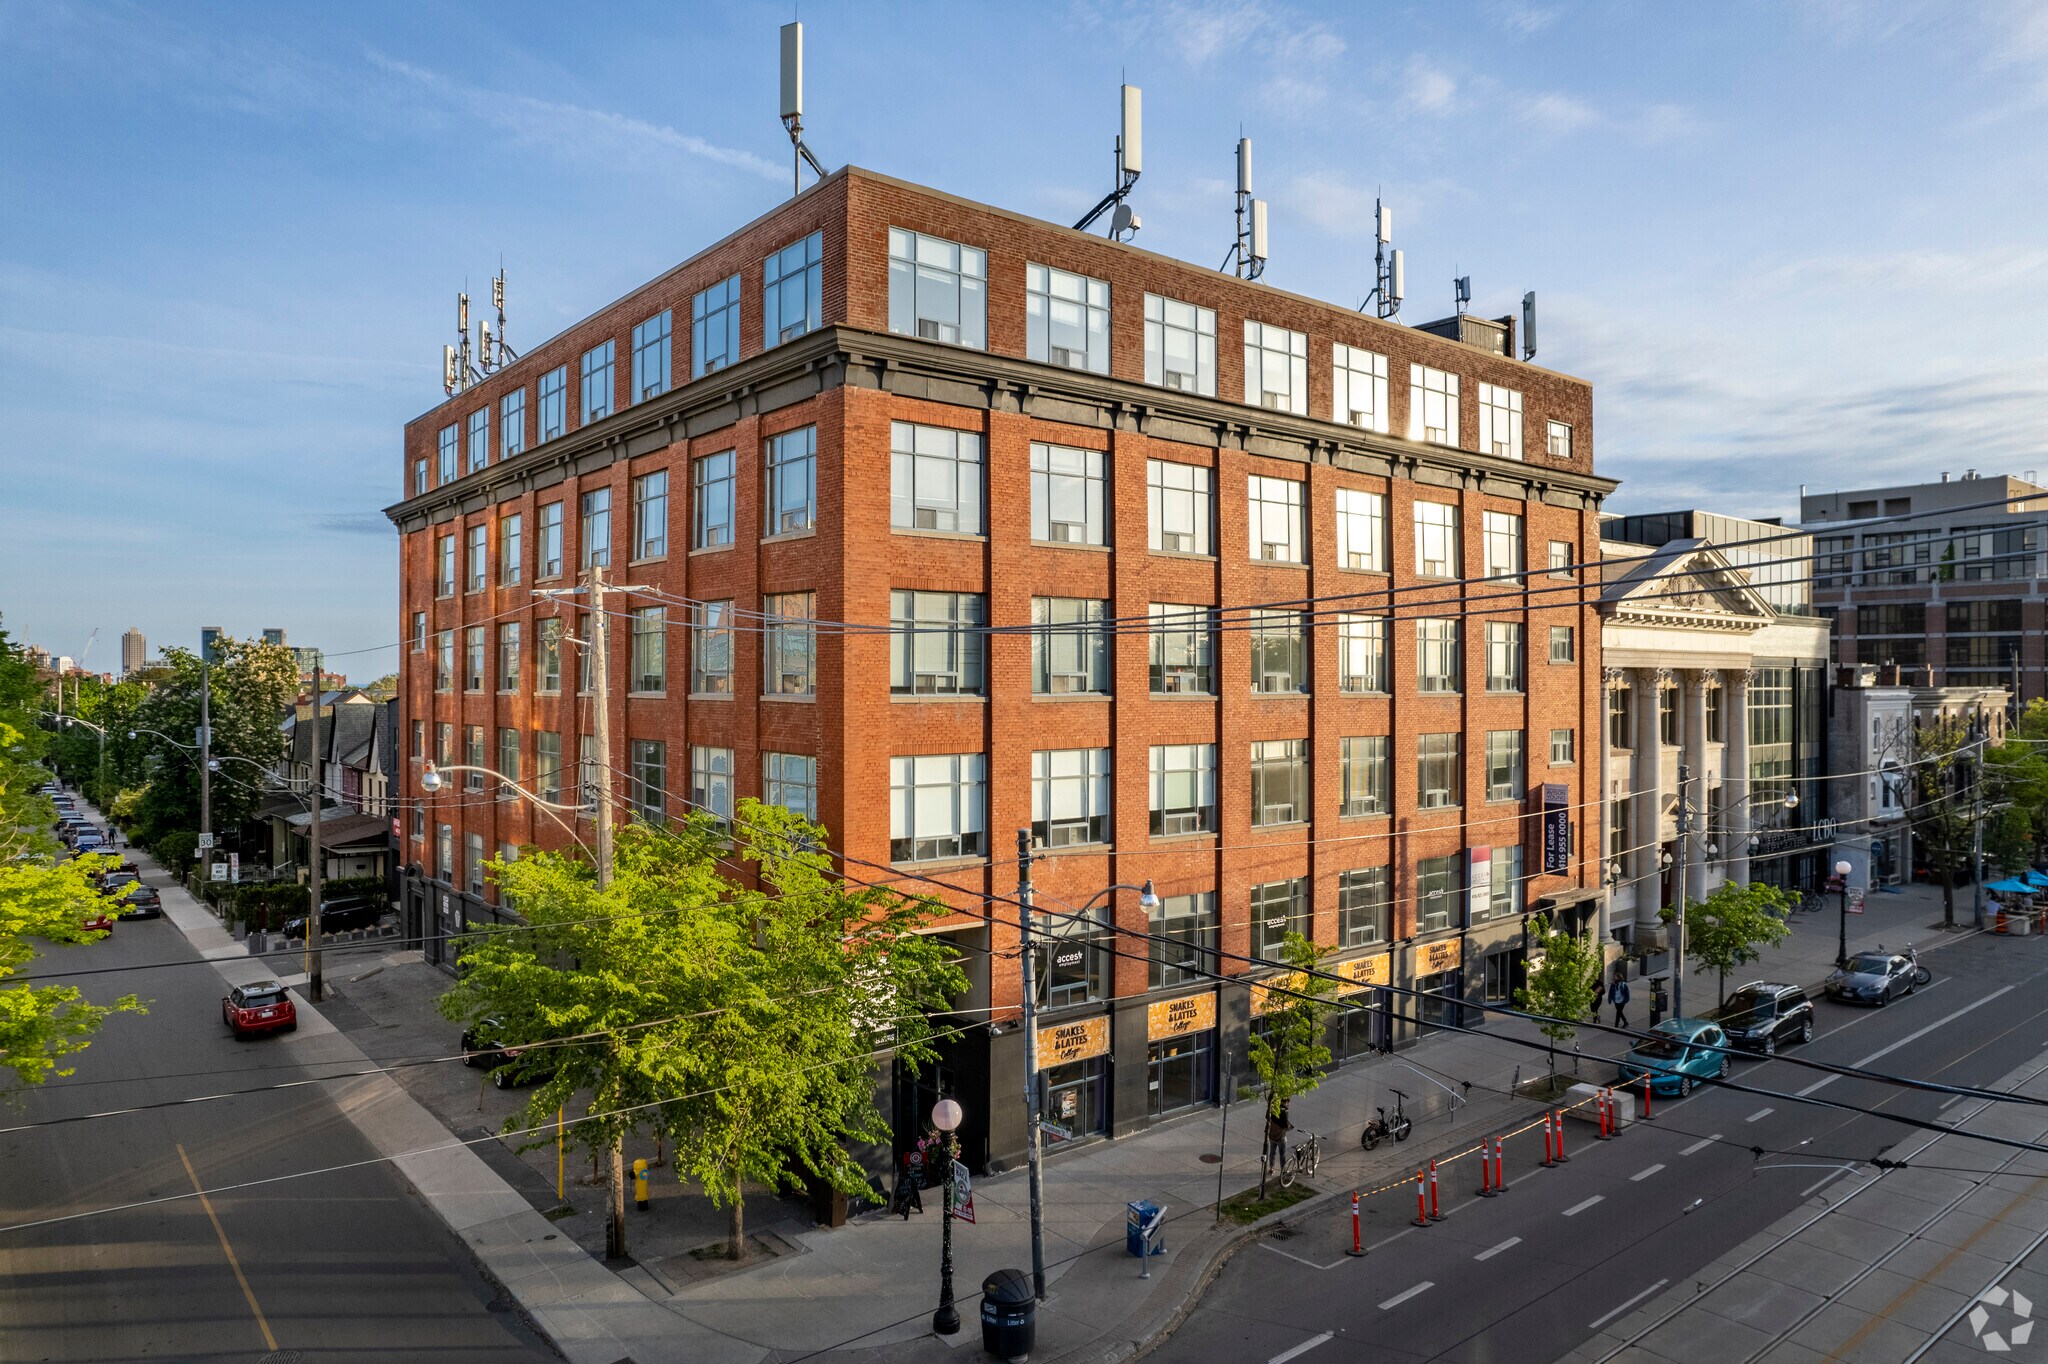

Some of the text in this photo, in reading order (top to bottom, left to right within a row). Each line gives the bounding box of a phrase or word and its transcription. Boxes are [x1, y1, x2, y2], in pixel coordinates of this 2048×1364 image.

[1813, 818, 1837, 841] LCBO
[1354, 960, 1373, 970] SNAKES
[1169, 1000, 1195, 1013] SNAKES
[1174, 1009, 1198, 1021] LATTES
[1055, 1025, 1085, 1039] SNAKES
[1173, 1020, 1192, 1032] College
[1061, 1034, 1087, 1048] LATTES
[1060, 1047, 1081, 1060] College
